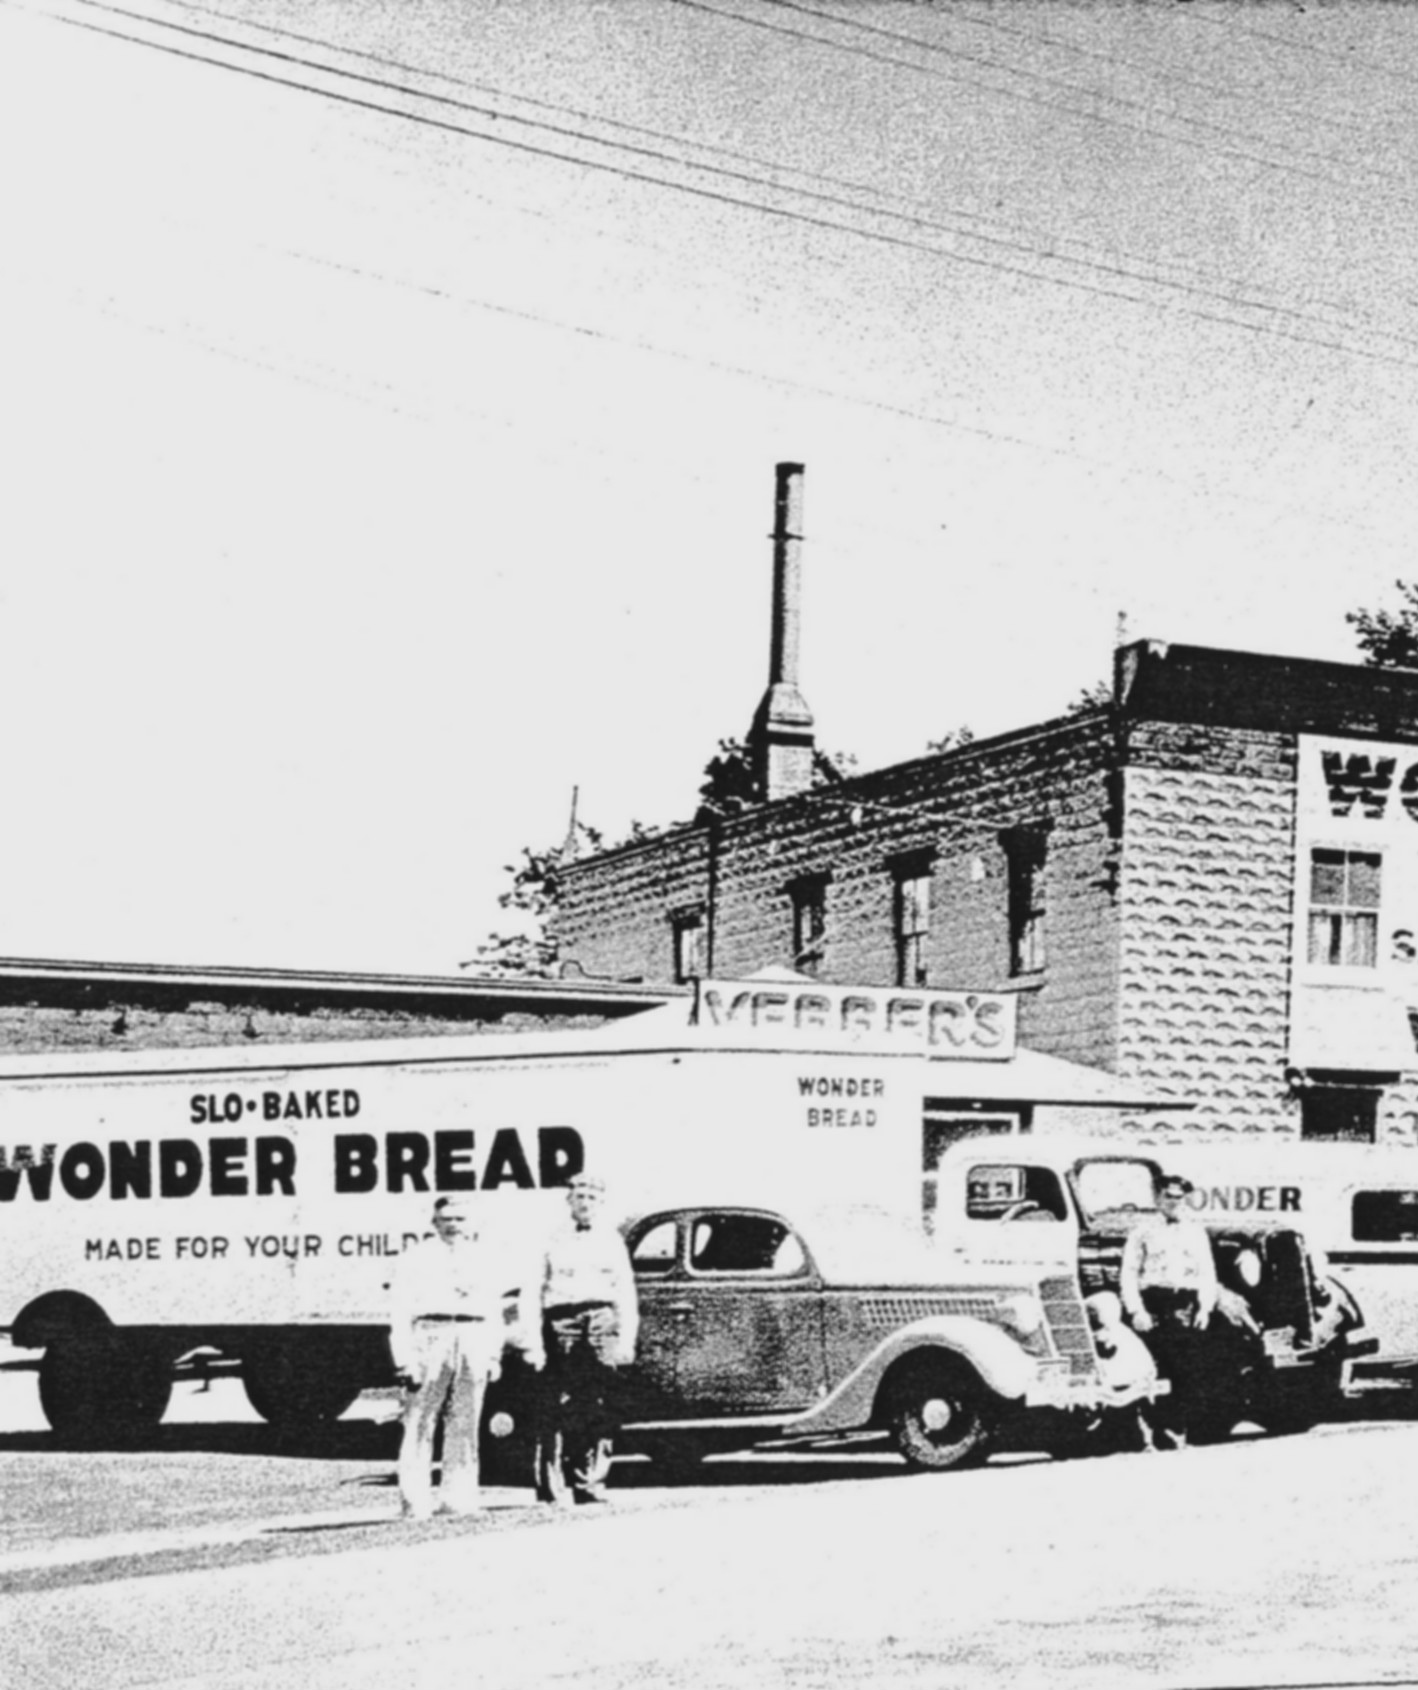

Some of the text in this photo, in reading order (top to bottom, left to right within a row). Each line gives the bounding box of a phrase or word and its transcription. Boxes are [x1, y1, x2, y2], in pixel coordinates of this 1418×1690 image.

[797, 1076, 885, 1098] WONDER
[807, 1107, 877, 1128] BREAD
[0, 1134, 297, 1202] WONDER
[332, 1124, 586, 1194] BREAD
[1183, 1184, 1303, 1213] ONDER
[84, 1236, 161, 1261] MADE
[174, 1235, 229, 1260] FOR
[244, 1233, 322, 1260] YOUR
